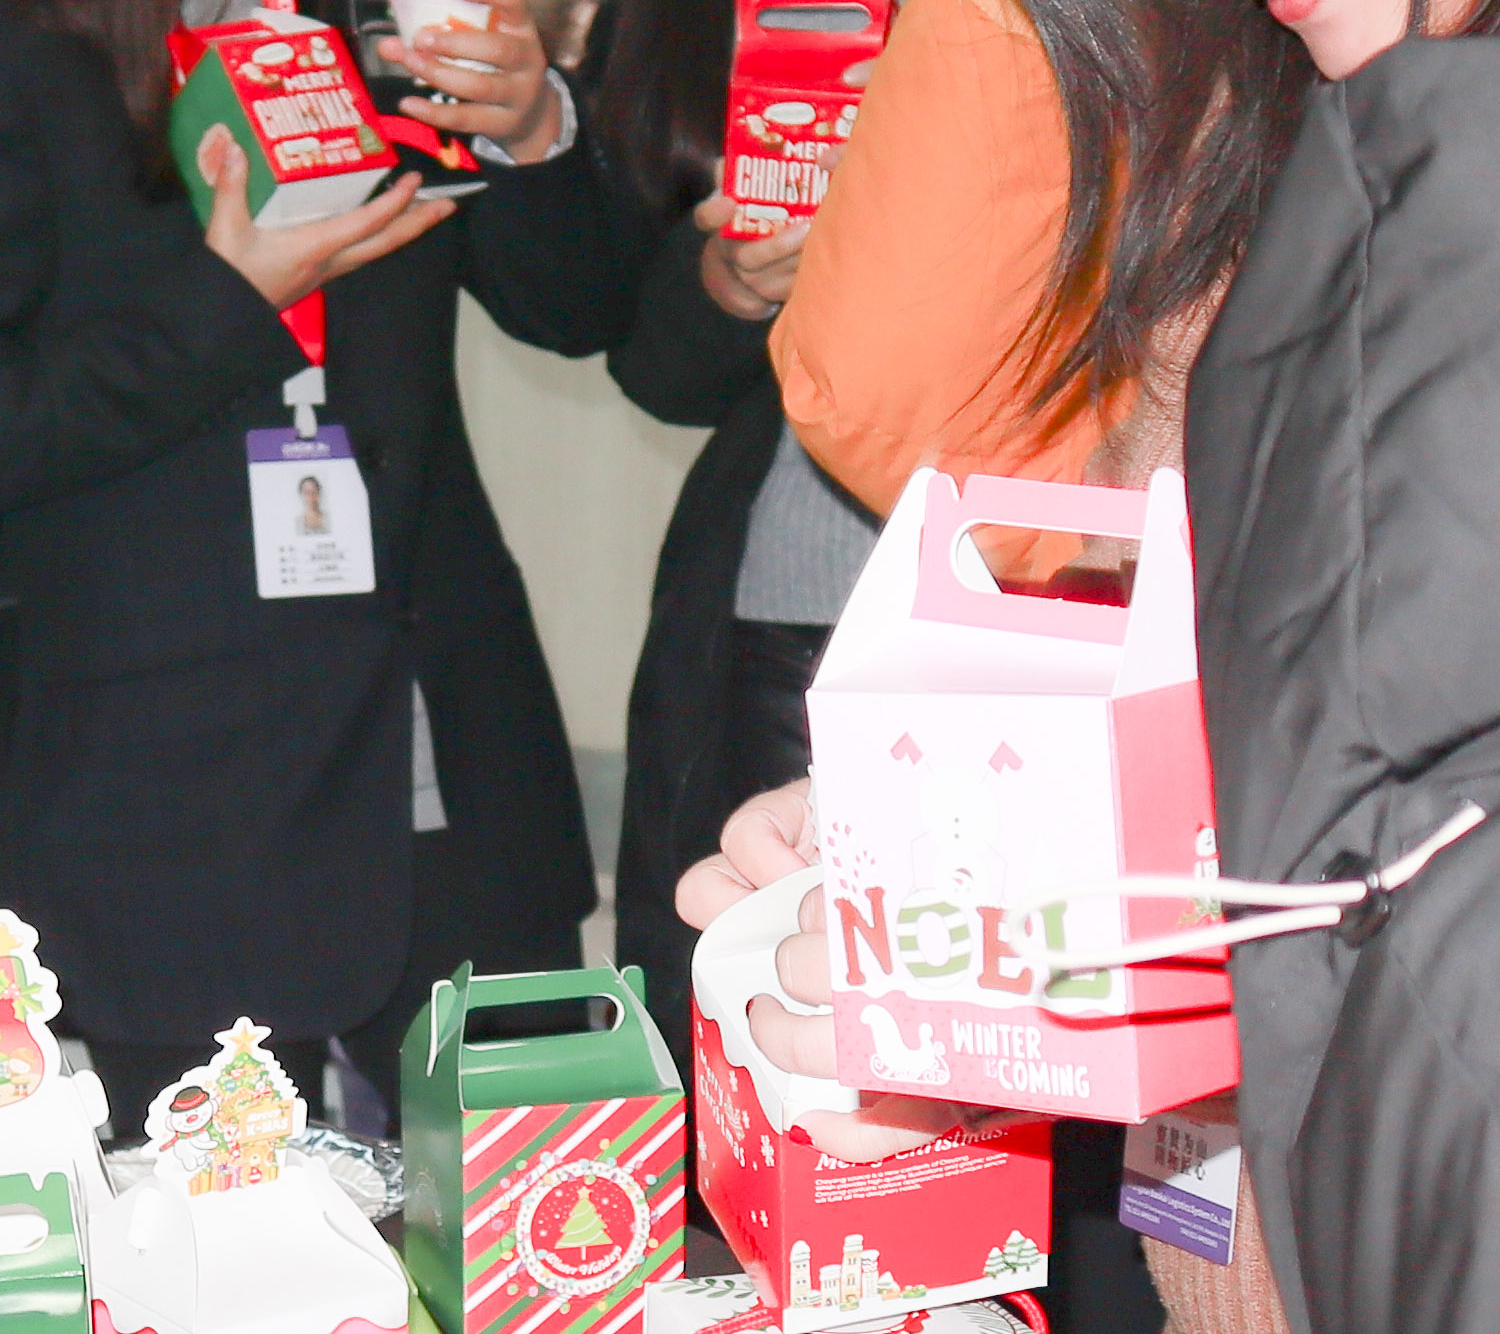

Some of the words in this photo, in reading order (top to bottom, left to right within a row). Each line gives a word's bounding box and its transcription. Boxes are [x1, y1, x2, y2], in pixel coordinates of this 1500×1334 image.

[283, 69, 345, 92] MERRY
[253, 88, 363, 139] CHRISTMAS
[735, 154, 830, 206] CHRISTM
[834, 887, 1112, 999] NOEL
[952, 1019, 1042, 1060] WINTER
[998, 1058, 1091, 1098] COMING
